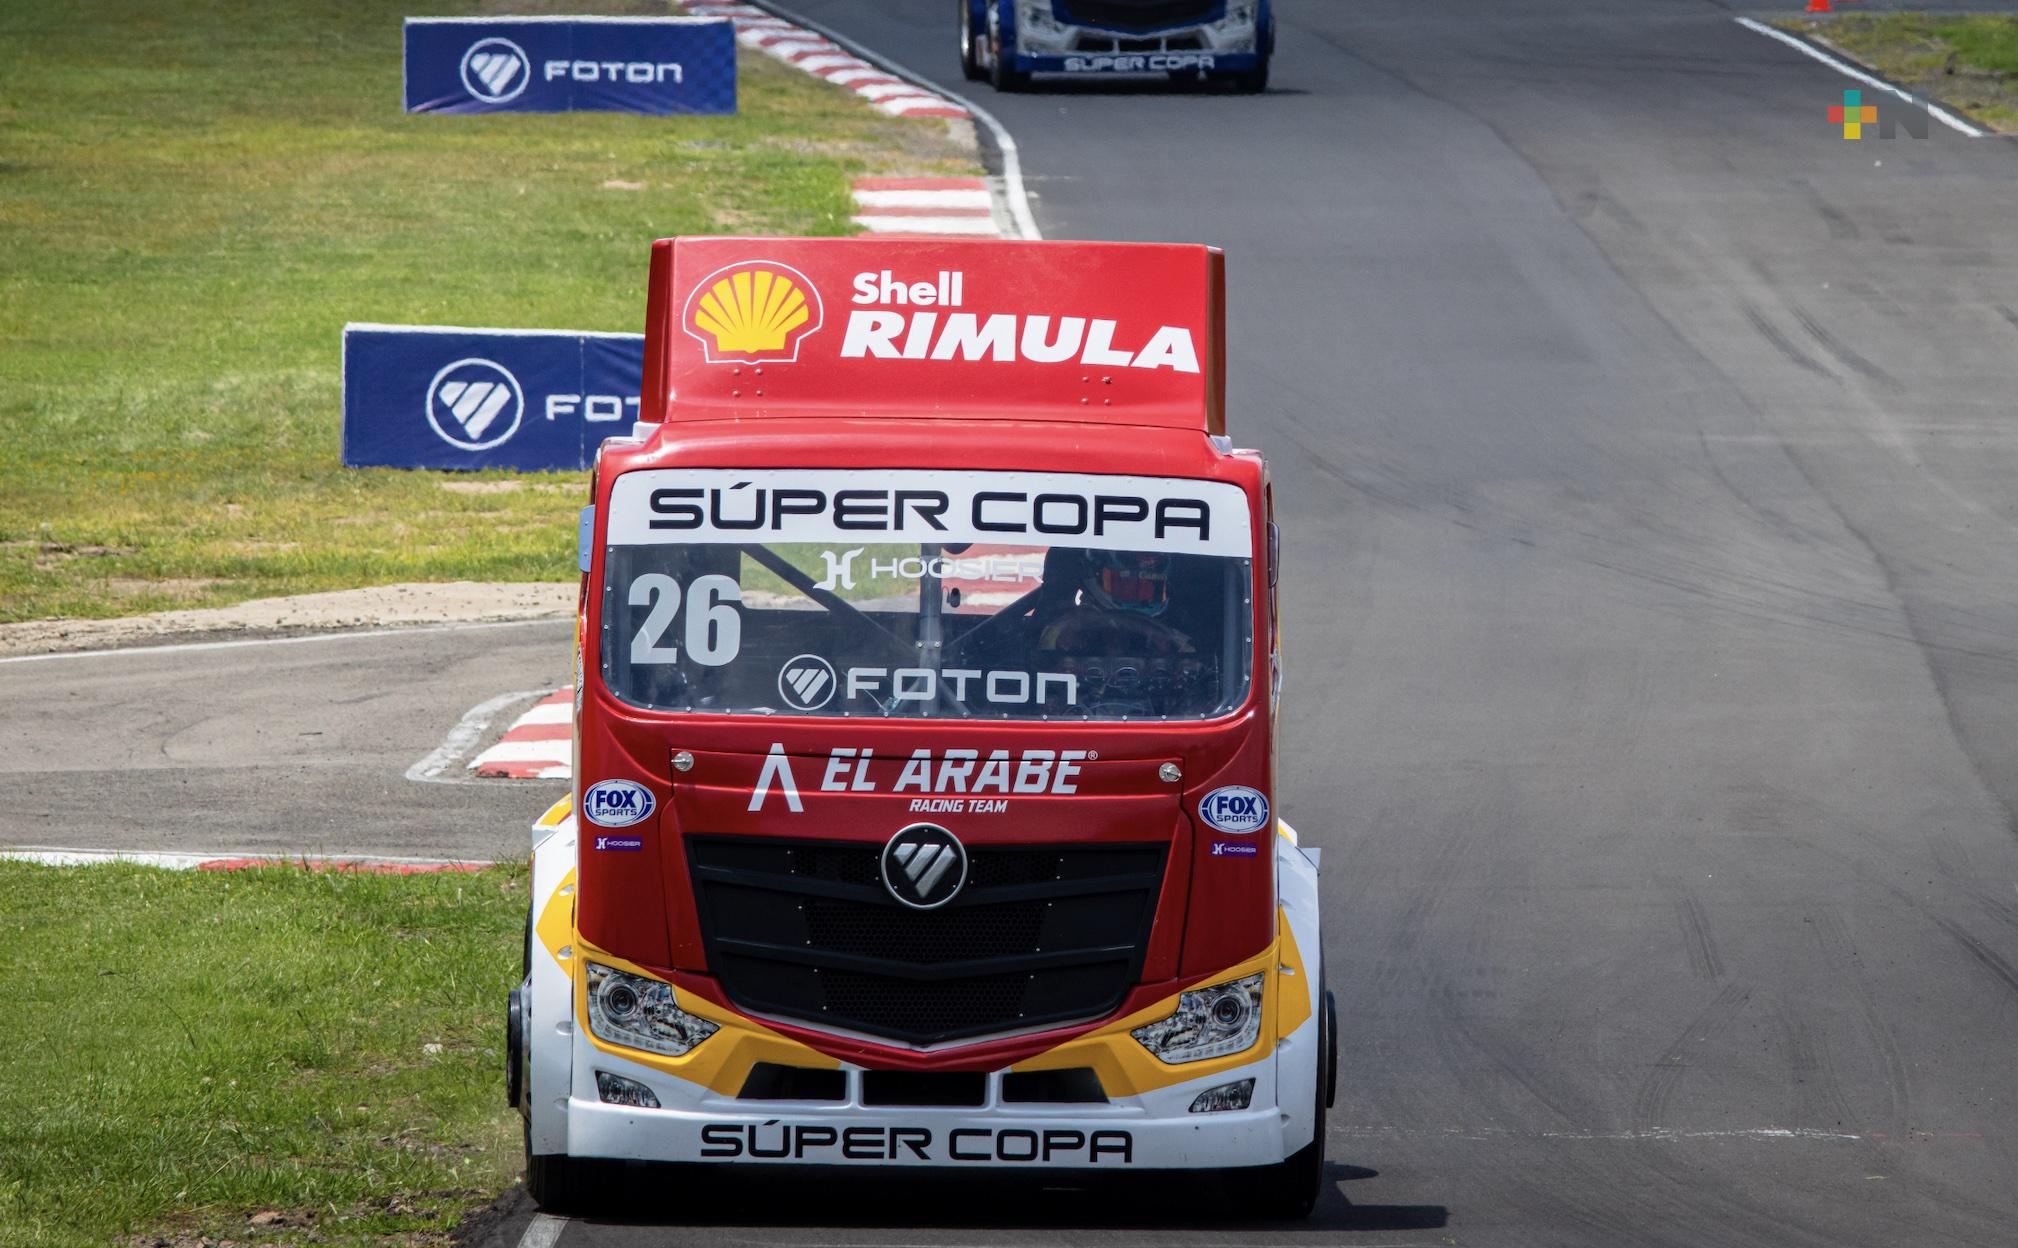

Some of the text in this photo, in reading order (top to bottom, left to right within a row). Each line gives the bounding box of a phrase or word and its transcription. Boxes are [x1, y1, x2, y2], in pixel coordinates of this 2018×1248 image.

[544, 60, 683, 83] FOTON
[1149, 55, 1215, 70] COPA
[851, 270, 963, 306] Shell
[840, 310, 1201, 374] RIMULA
[649, 482, 1211, 541] SÚPER COPA
[870, 557, 1044, 583] HOOSIER
[628, 573, 742, 666] 26
[847, 667, 1077, 705] FOTON
[820, 747, 876, 793] EL
[595, 808, 638, 816] SPORTS
[596, 790, 637, 808] FOX
[908, 799, 1009, 814] RACING TEAM
[1217, 796, 1257, 815] FOX
[1216, 815, 1259, 823] SPORTS
[701, 1119, 1133, 1163] SÚPER COPA
